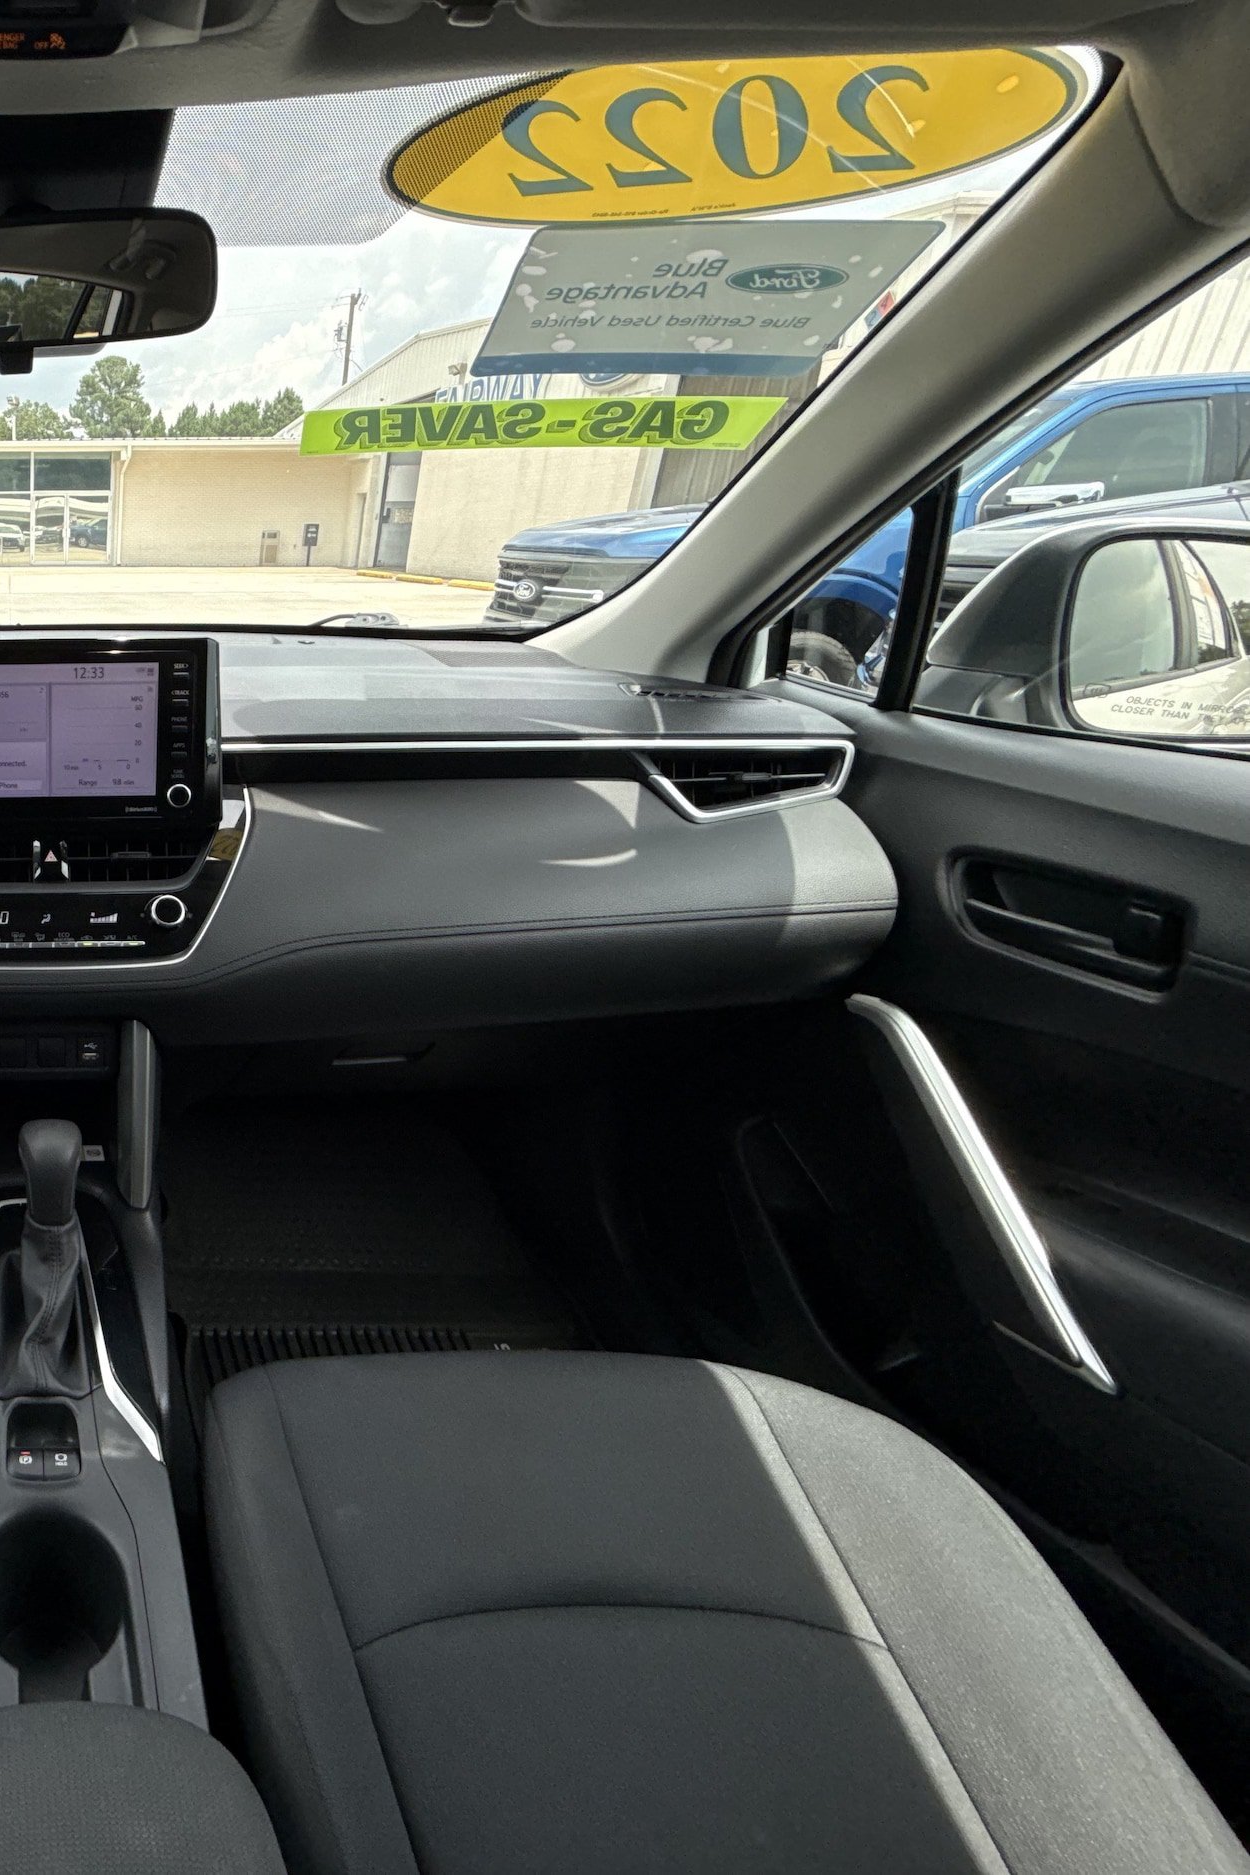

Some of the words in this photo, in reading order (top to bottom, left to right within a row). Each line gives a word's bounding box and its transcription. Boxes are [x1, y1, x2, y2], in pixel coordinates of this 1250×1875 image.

[73, 666, 105, 679] 12:33
[1126, 696, 1175, 708] OBJECTS
[1180, 701, 1193, 711] IN
[1111, 704, 1155, 716] CLOSER
[1160, 709, 1190, 720] THAN
[78, 779, 98, 787] Range
